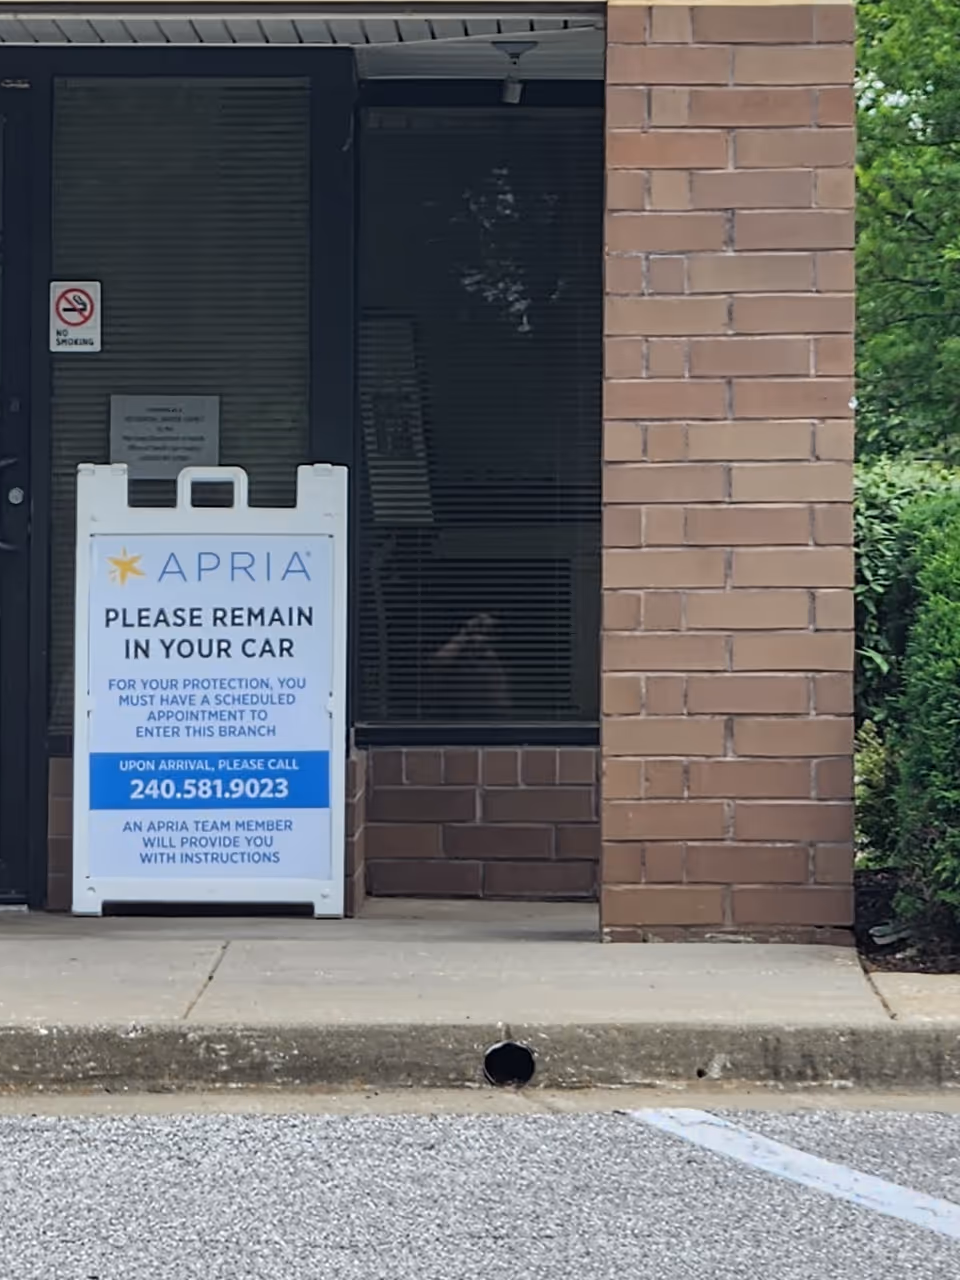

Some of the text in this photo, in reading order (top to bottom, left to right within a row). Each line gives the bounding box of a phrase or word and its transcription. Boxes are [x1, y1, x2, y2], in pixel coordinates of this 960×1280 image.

[55, 328, 69, 337] NO
[55, 338, 95, 346] SMOKING
[105, 606, 313, 628] PLEASE REMAIN
[125, 637, 294, 660] IN YOUR CAR
[108, 677, 306, 692] FOR YOUR PROTECTION, YOU
[118, 693, 296, 707] MUST HAVE A SCHEDULED
[146, 709, 268, 722] APPOINTMENT TO
[135, 724, 276, 738] ENTER THIS BRANCH
[119, 758, 299, 773] UPON ARRIVAL, PLEASE CALL
[129, 777, 289, 800] 240.581.9023
[122, 819, 293, 833] AN APRIA TEAM MEMBER
[142, 835, 274, 849] WILL PROVIDE YOU
[139, 851, 281, 865] WITH INSTRUCTIONS
